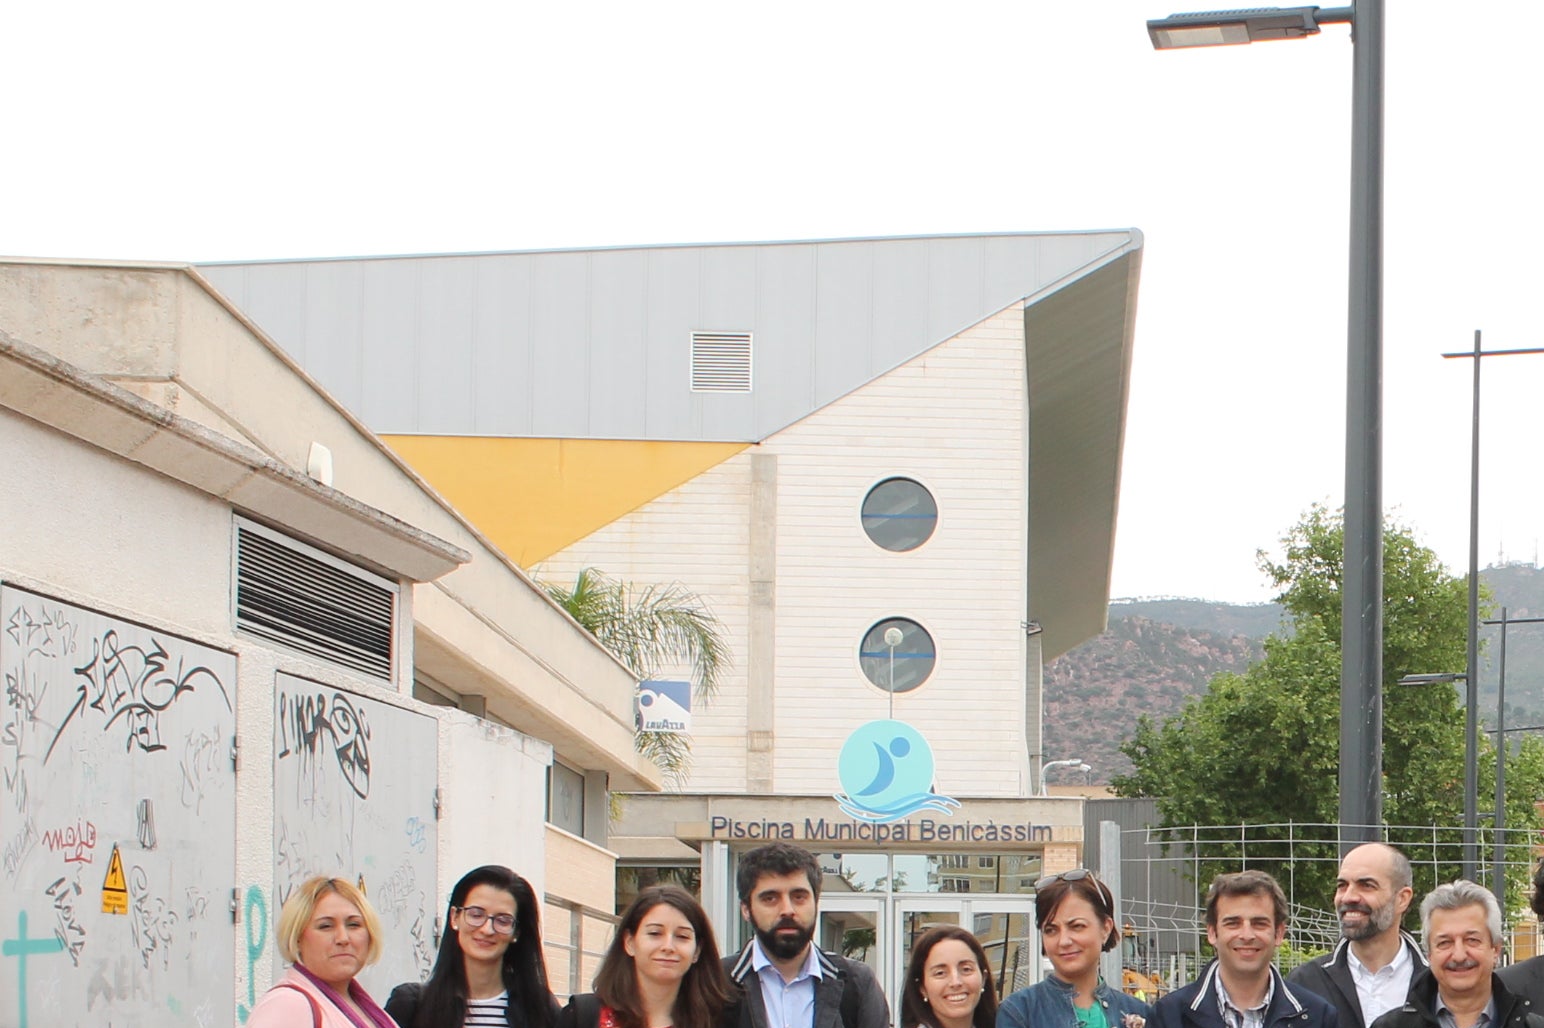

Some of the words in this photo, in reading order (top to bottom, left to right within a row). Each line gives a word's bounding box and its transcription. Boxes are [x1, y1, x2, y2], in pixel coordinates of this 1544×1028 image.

[711, 816, 795, 839] Piscina
[804, 817, 911, 845] Municipal
[920, 819, 1053, 842] Benicàssim
